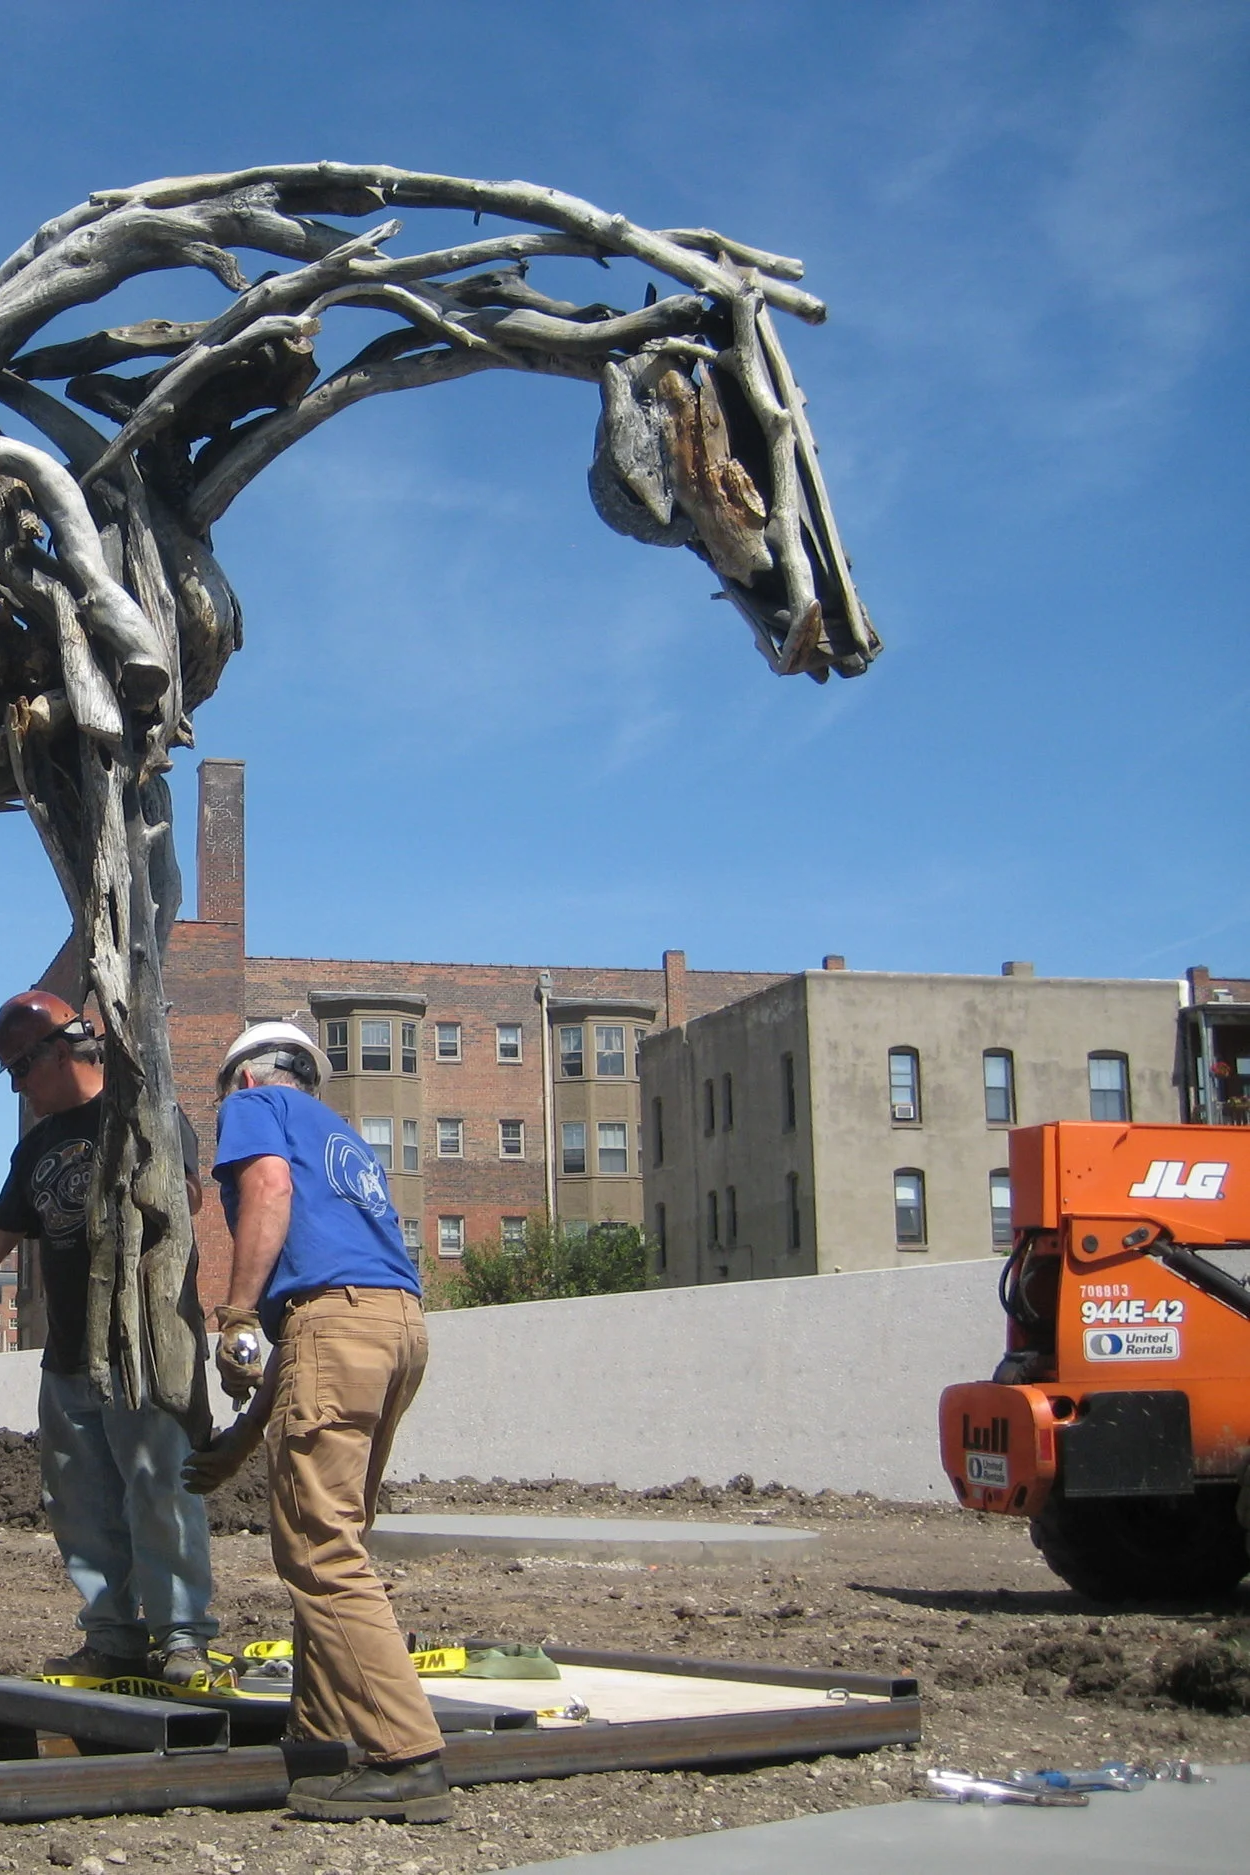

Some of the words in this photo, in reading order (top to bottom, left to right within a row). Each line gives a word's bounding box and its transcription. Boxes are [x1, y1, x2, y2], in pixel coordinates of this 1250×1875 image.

[1127, 1160, 1229, 1200] JLG
[1081, 1300, 1183, 1323] 944E-42
[1125, 1333, 1169, 1344] United
[1125, 1344, 1174, 1355] Rentals
[413, 1652, 446, 1670] WE
